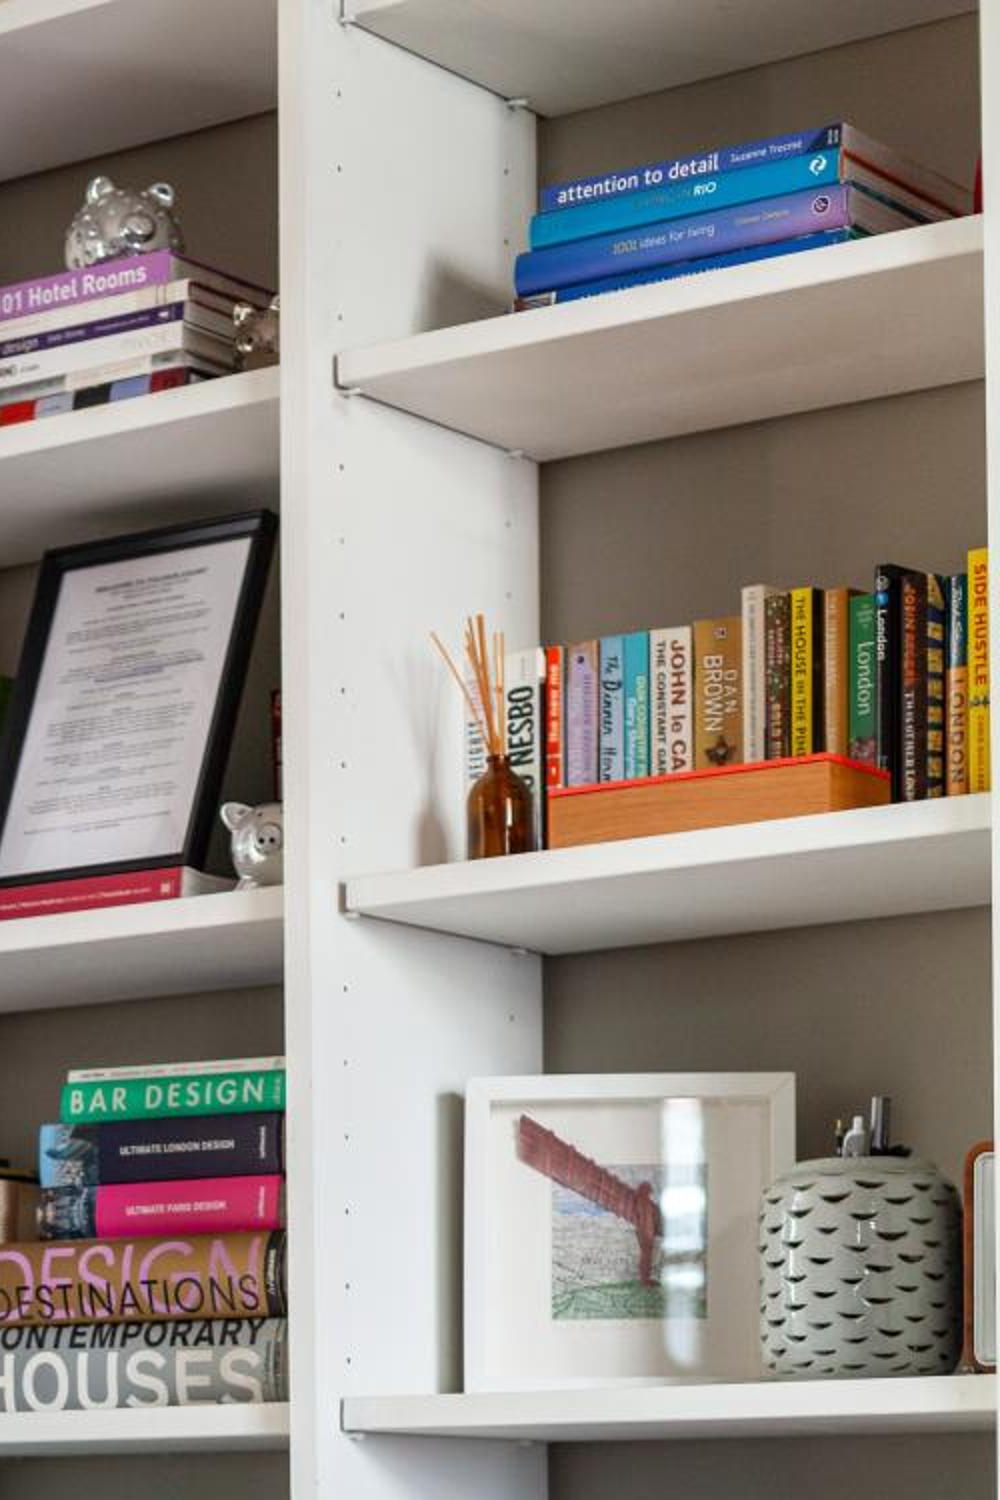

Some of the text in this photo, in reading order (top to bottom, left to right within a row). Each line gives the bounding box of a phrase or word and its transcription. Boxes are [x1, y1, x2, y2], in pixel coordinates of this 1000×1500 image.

[557, 177, 639, 204] attention
[645, 169, 662, 185] to
[668, 154, 719, 180] detail
[27, 279, 78, 305] Hotel
[81, 265, 148, 295] Rooms
[796, 595, 807, 622] THE
[974, 563, 988, 686] SIDE HUSTLE
[657, 642, 666, 667] THE
[795, 624, 807, 674] HOUSE
[877, 609, 889, 661] London
[670, 640, 686, 705] JOHN
[703, 655, 723, 732] BROWN
[724, 669, 738, 714] DAN
[857, 641, 874, 716] London
[602, 680, 622, 735] Dinner
[657, 672, 666, 743] CONSTANT
[671, 714, 686, 733] le
[796, 698, 807, 722] THE
[951, 675, 965, 784] LONDON
[70, 1087, 127, 1114] BAR
[145, 1077, 265, 1110] DESIGN
[119, 1139, 235, 1156] ULTIMATE LONDON DESIGN
[125, 1203, 164, 1217] ULTIMATE
[193, 1200, 227, 1213] DESIGN
